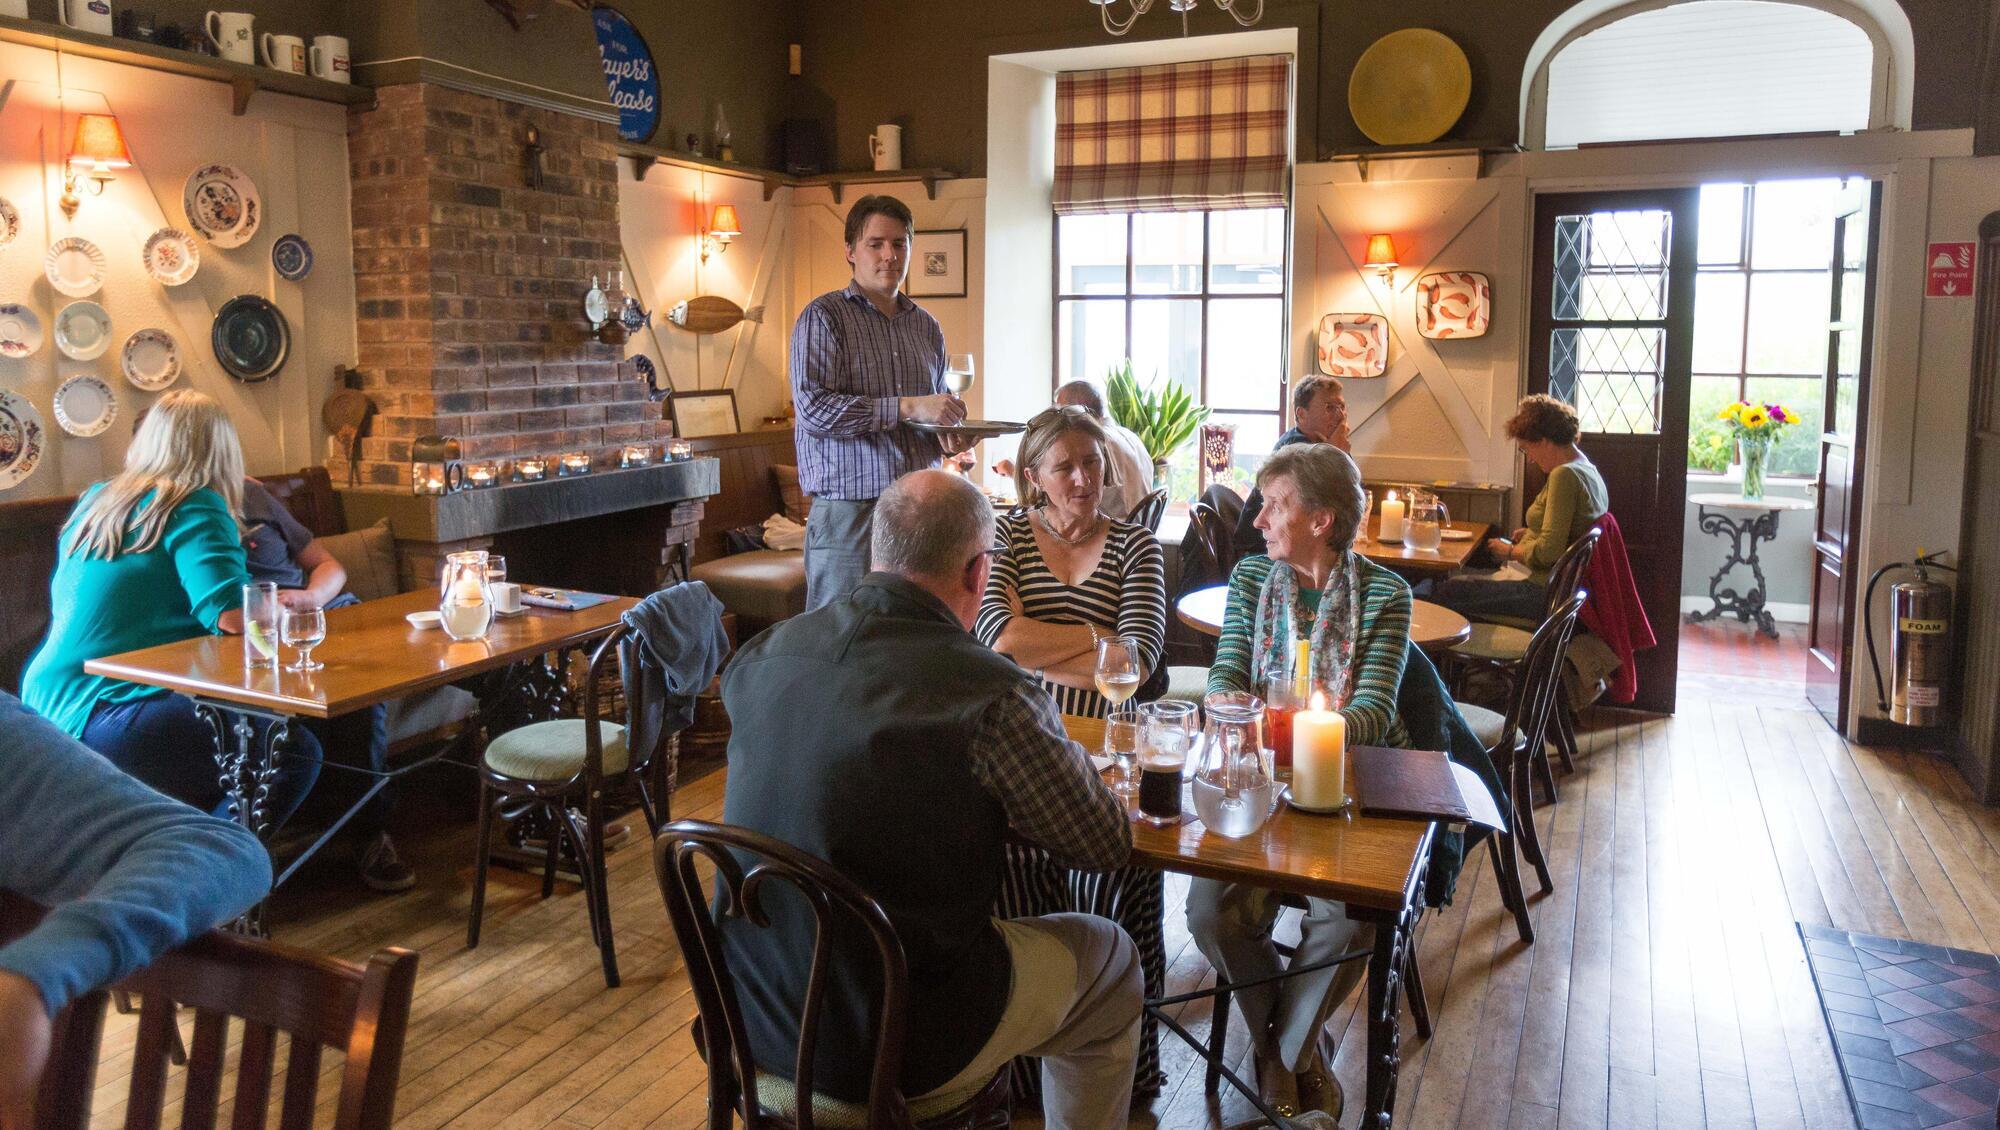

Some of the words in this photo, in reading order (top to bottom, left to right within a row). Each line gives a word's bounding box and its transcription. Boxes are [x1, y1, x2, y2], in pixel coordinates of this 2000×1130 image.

[600, 46, 649, 83] ayer's
[608, 80, 654, 112] lease
[1949, 271, 1968, 279] Point
[1907, 622, 1941, 631] FOAM
